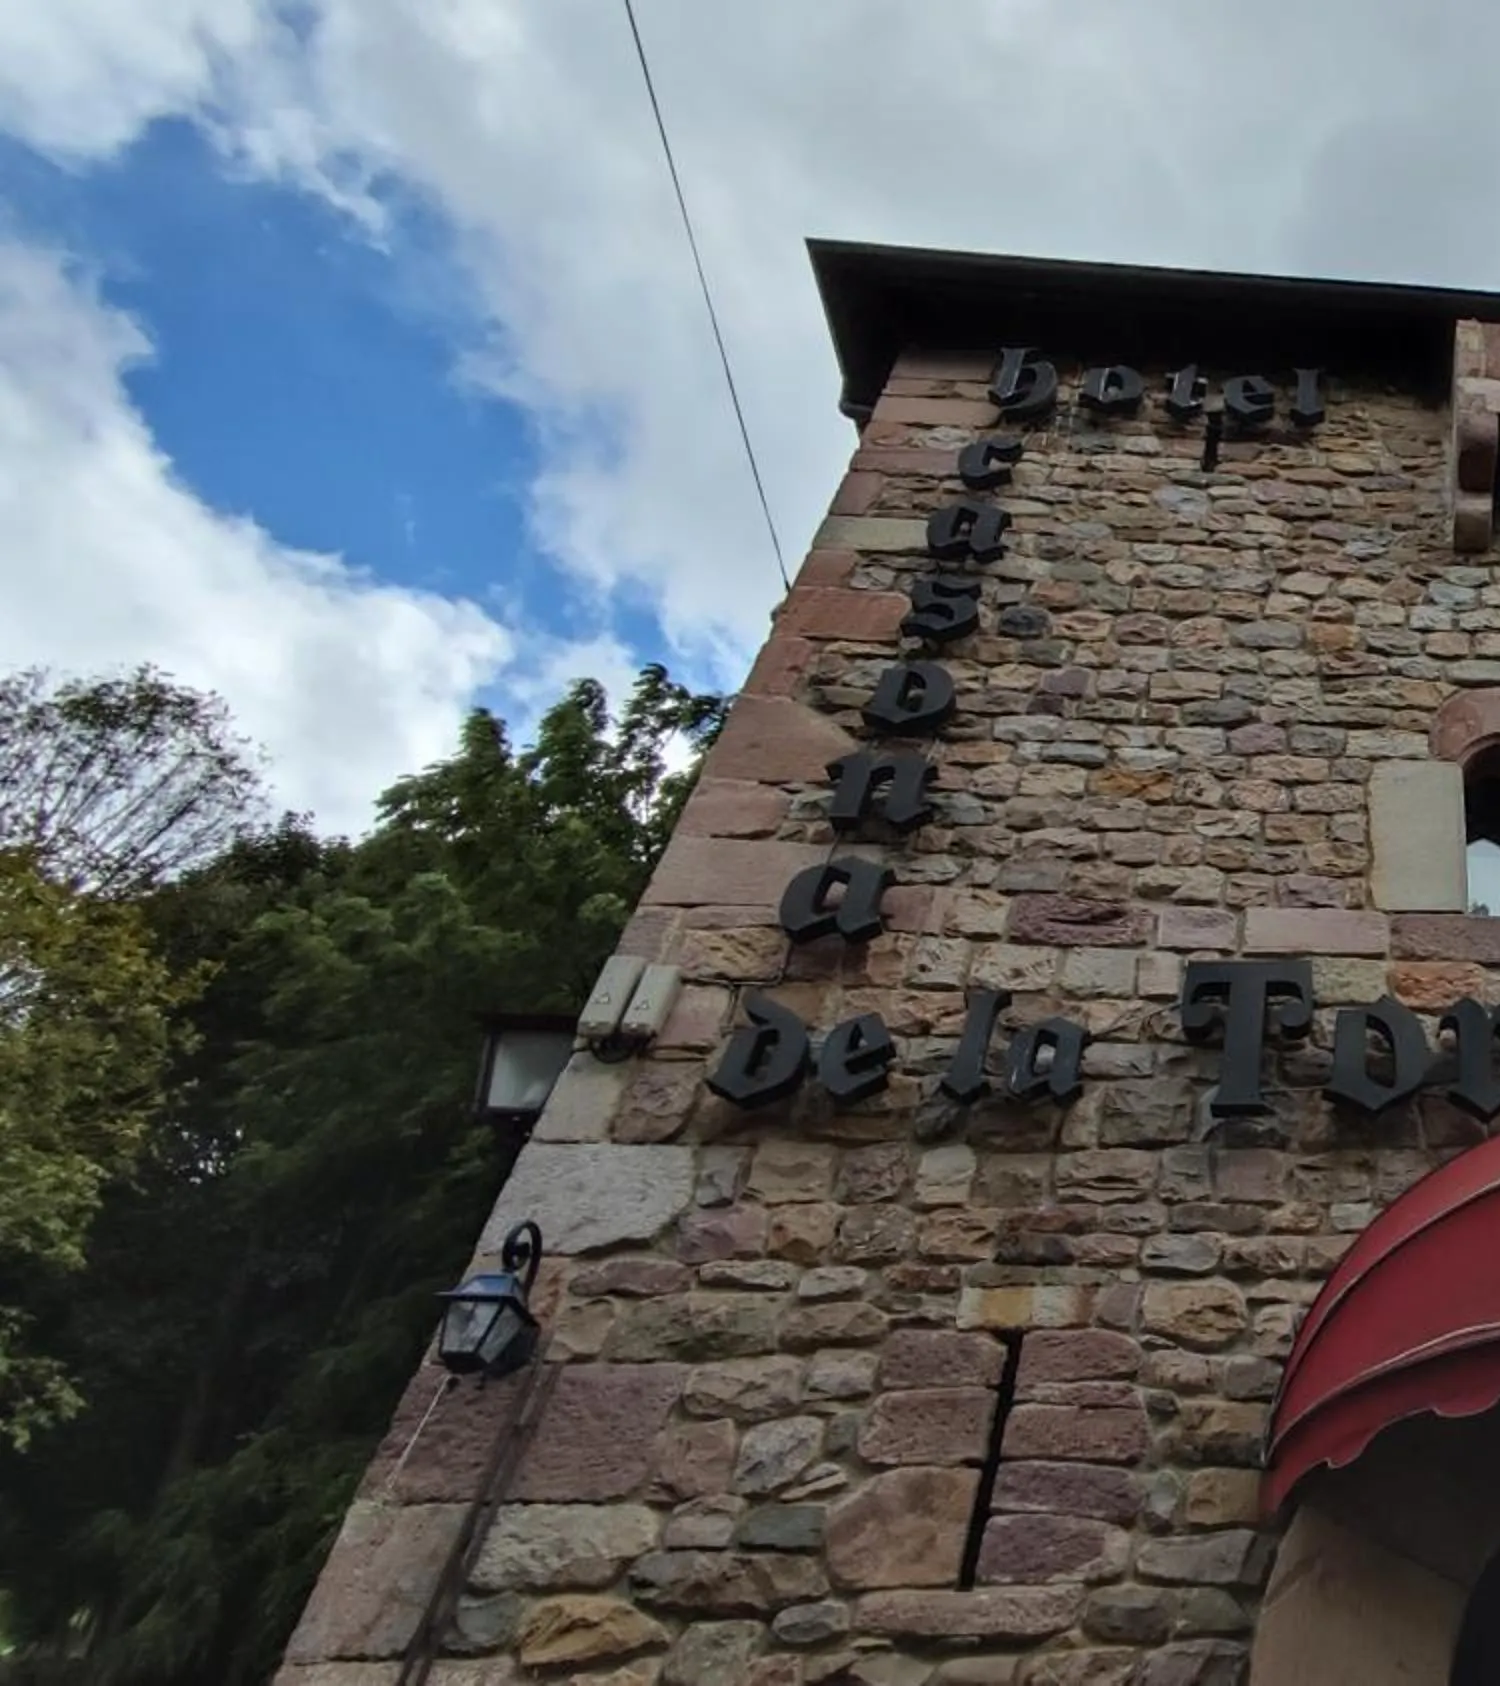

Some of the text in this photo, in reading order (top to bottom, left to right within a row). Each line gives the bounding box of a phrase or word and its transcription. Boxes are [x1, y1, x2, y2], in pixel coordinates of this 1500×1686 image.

[989, 347, 1325, 426] hotel
[779, 434, 1023, 944] casona
[709, 988, 895, 1107] de
[940, 988, 1091, 1102] la
